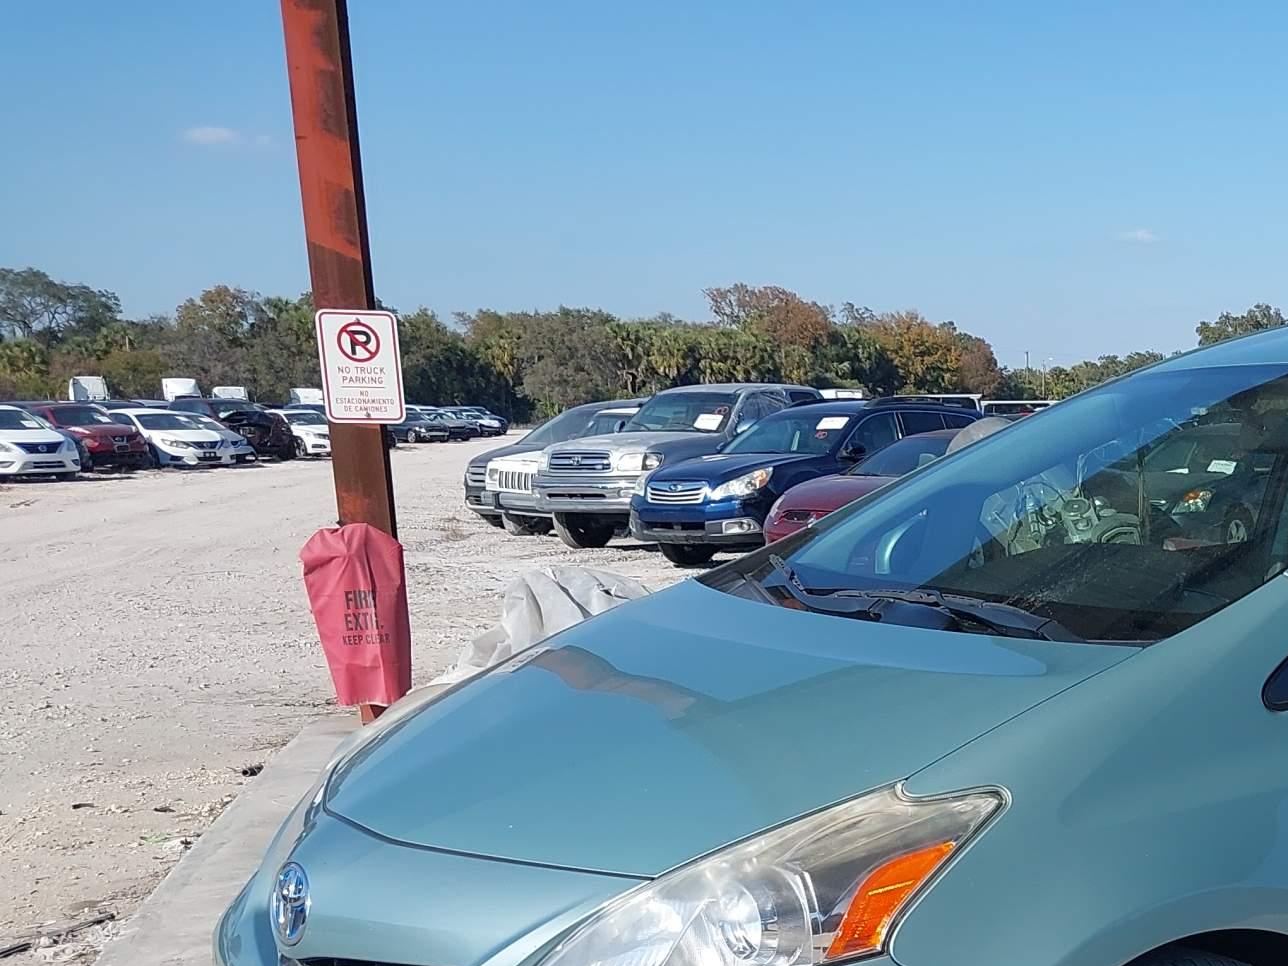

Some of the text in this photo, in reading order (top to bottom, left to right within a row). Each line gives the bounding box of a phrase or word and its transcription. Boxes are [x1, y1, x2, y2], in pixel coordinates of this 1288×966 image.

[337, 366, 386, 375] NO TRUCK
[342, 376, 384, 384] PARKING
[335, 397, 395, 405] ESTACIONAMIENTO
[354, 405, 388, 413] CAMIONES
[342, 633, 392, 646] KEEP CLEAR
